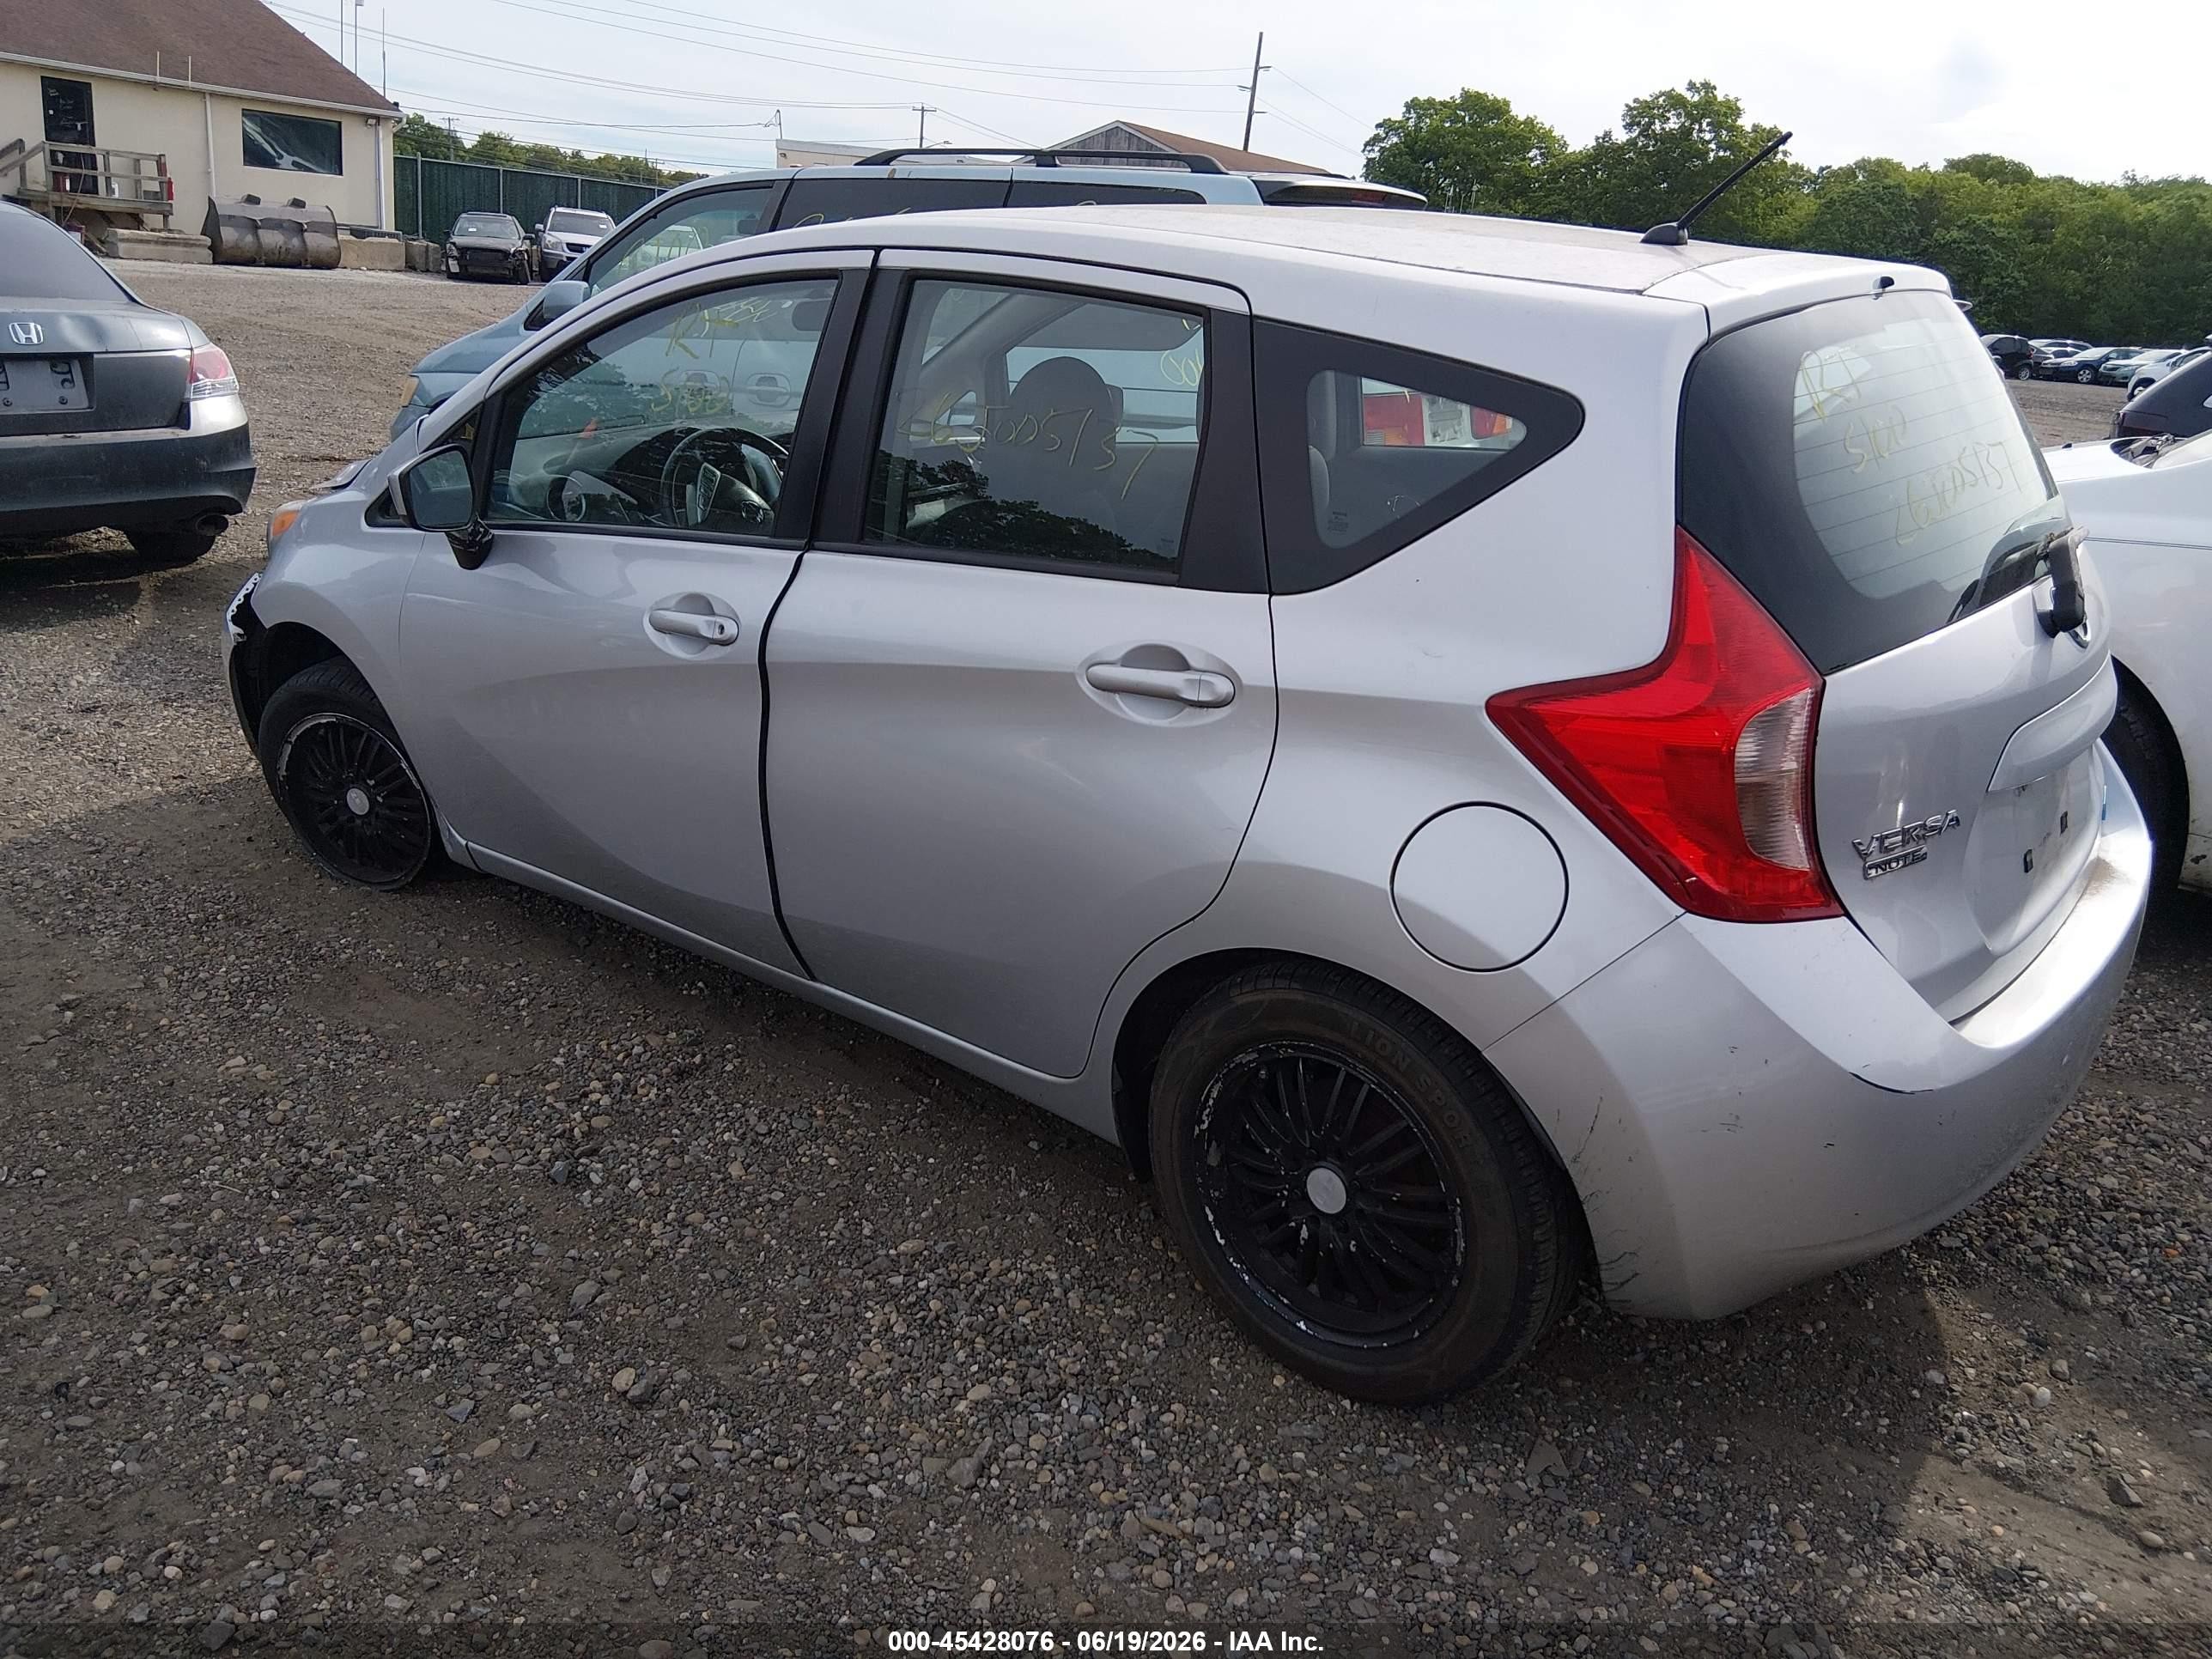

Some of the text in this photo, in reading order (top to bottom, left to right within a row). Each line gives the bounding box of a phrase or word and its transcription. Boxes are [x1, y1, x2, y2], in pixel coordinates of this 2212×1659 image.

[1851, 809, 1960, 861] VERSA
[1866, 848, 1928, 877] NOTE
[1348, 1021, 1477, 1153] LION SPOR
